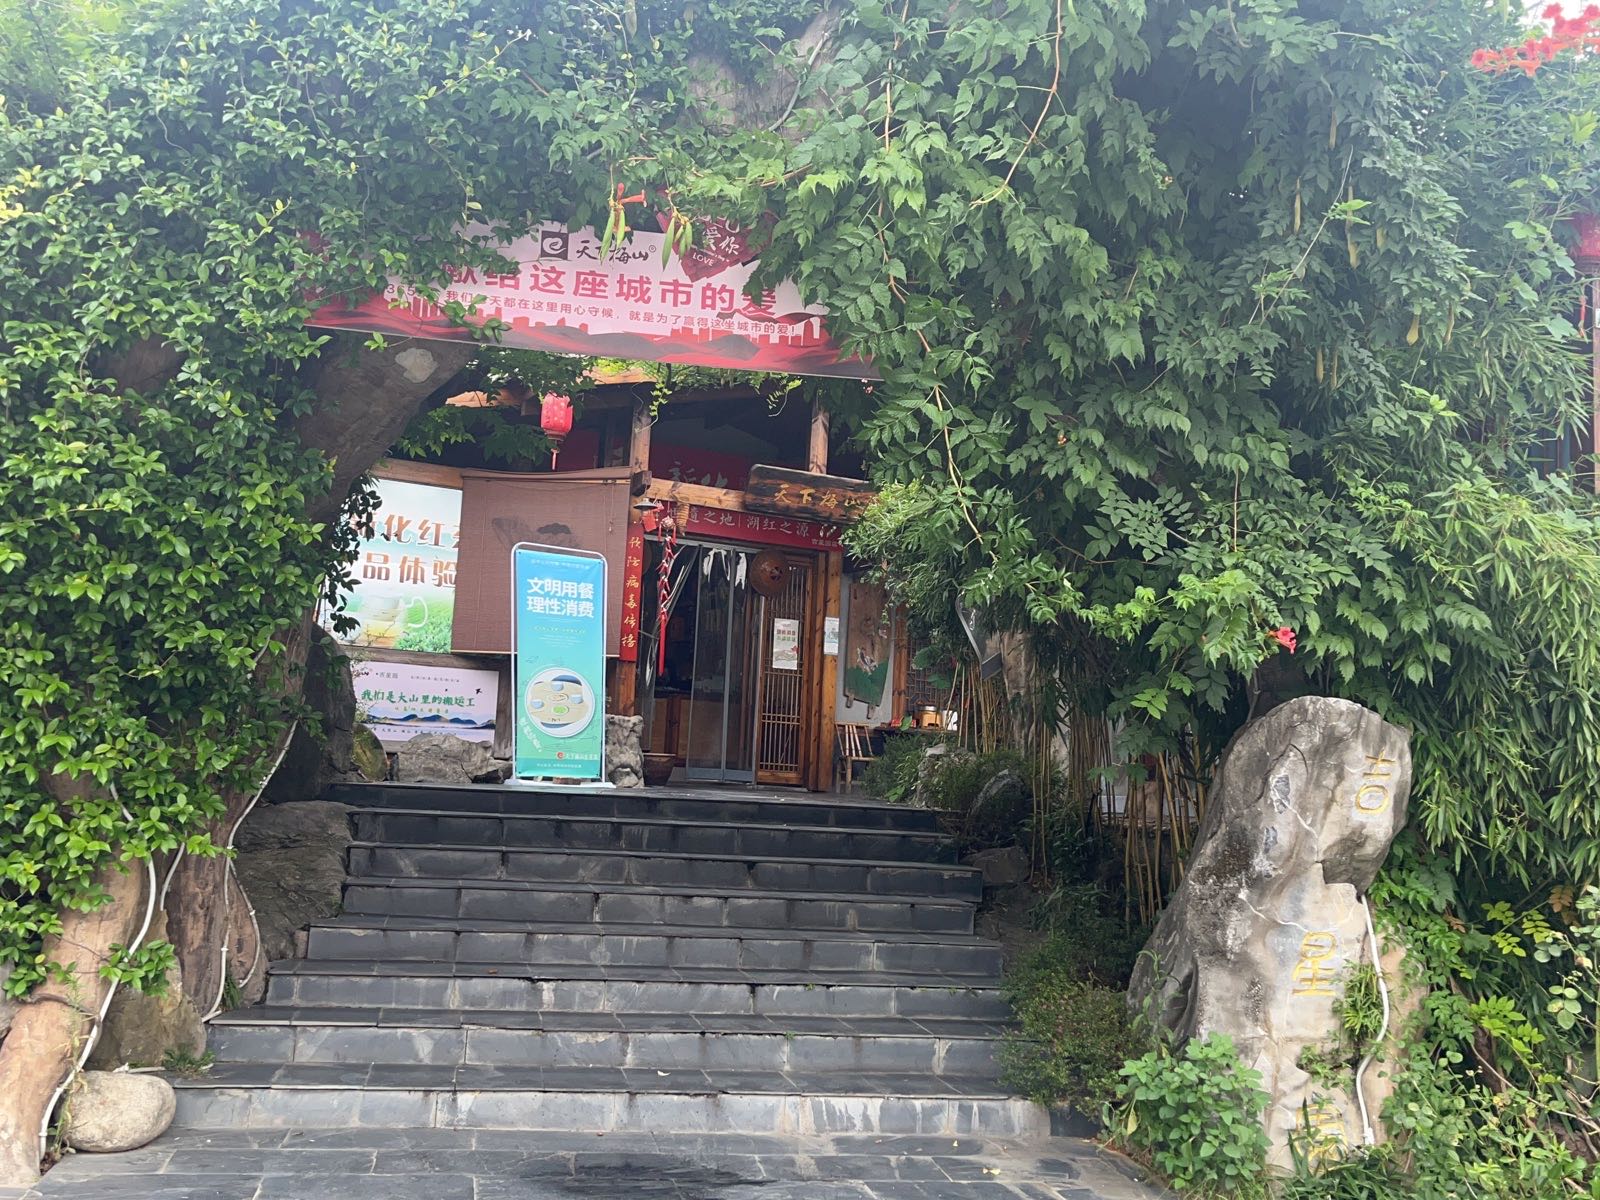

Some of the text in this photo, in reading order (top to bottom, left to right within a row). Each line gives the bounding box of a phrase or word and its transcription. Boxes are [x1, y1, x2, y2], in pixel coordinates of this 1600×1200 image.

[692, 252, 715, 267] LOVE
[363, 552, 456, 587] 品体验
[527, 577, 594, 600] 文明用餐
[526, 595, 594, 618] 理性消费
[361, 688, 476, 708] 我们是大山里的搬运工
